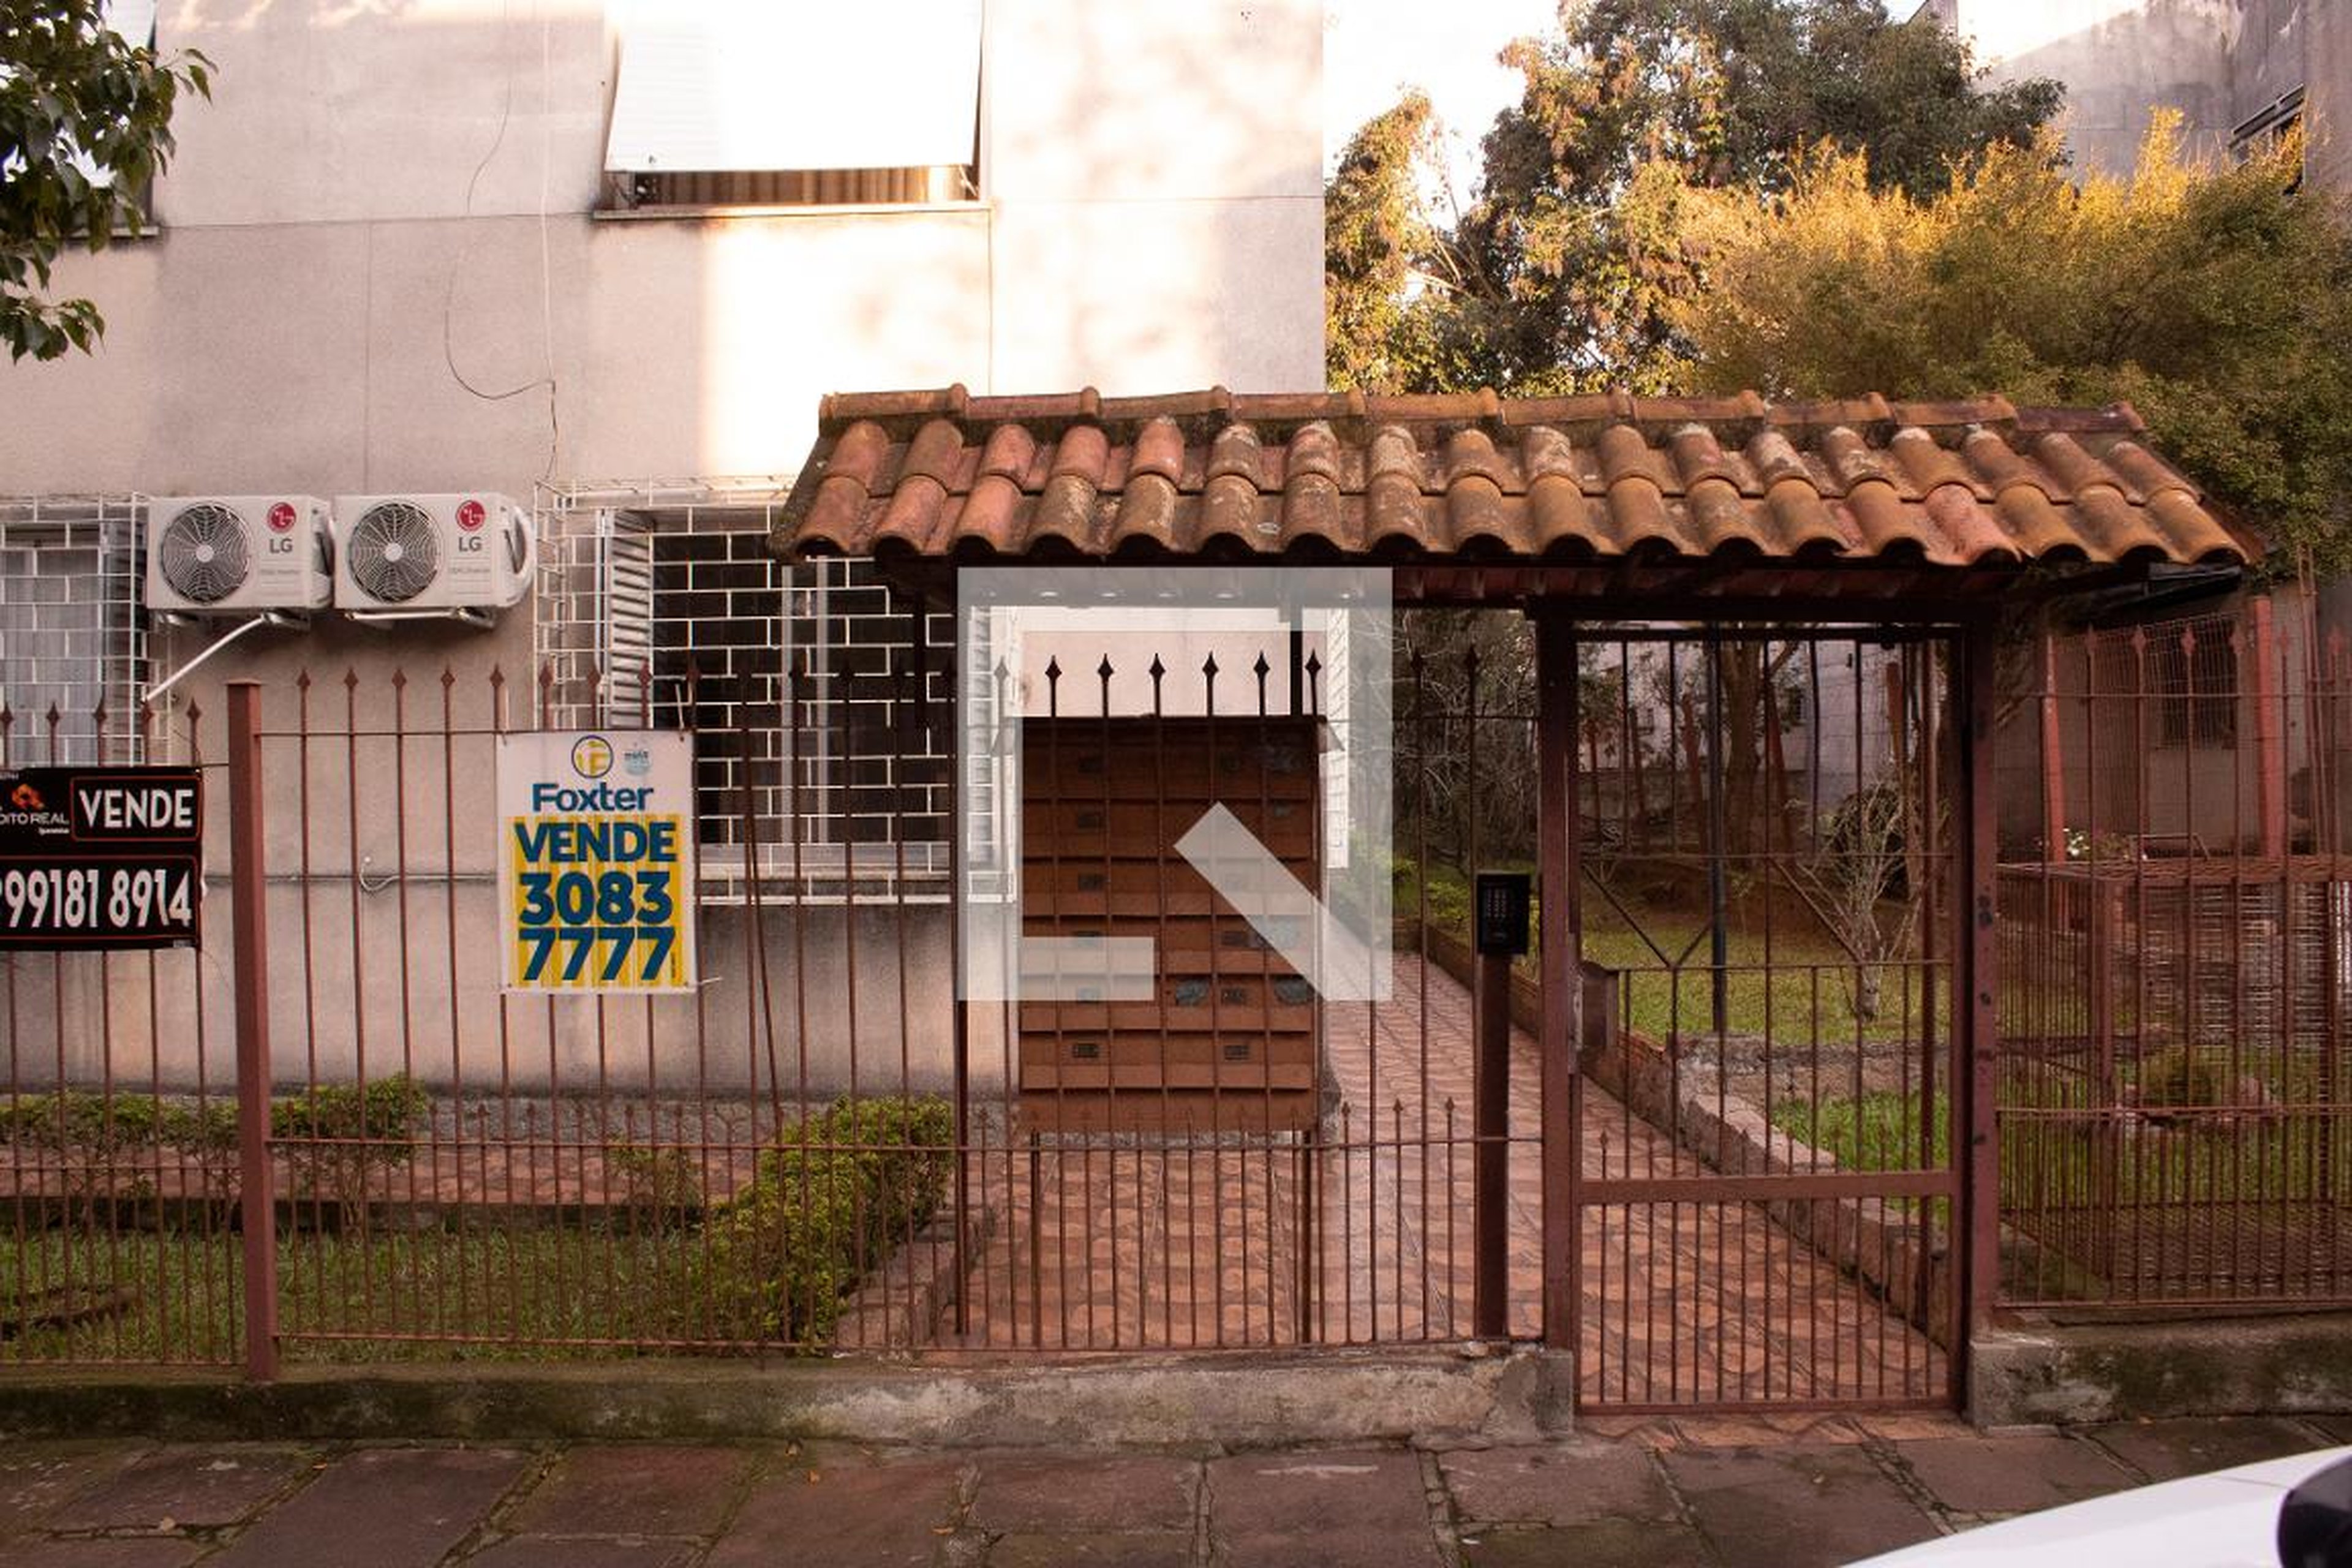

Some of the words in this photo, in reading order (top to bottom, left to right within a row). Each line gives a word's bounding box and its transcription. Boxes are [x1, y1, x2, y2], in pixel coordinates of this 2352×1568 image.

[270, 537, 293, 554] LG
[458, 536, 482, 552] LG
[79, 790, 193, 827] VENDE
[532, 782, 654, 812] Foxter
[29, 812, 70, 825] REAL
[514, 821, 677, 862] VENDE
[5, 869, 99, 928] 99181
[108, 869, 192, 928] 8914
[518, 871, 673, 925] 3083
[518, 927, 676, 981] 7777
